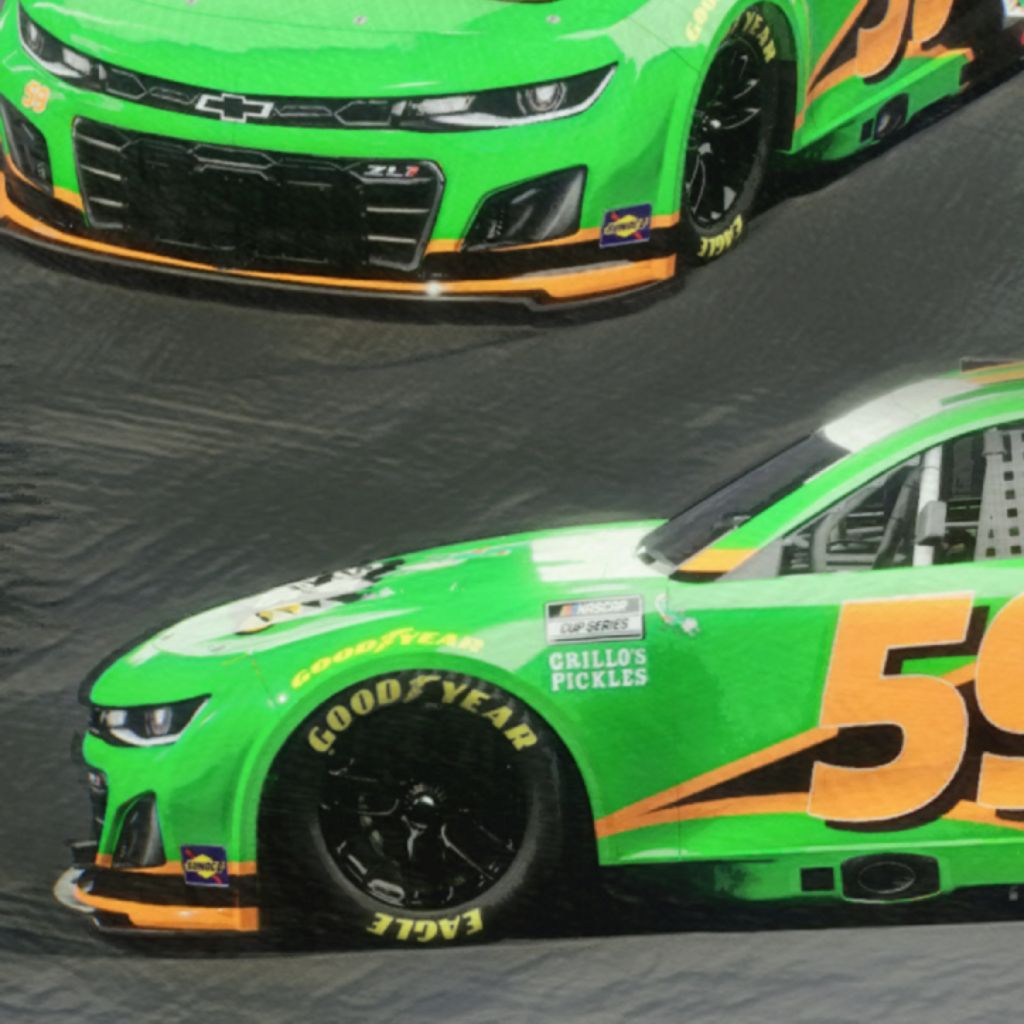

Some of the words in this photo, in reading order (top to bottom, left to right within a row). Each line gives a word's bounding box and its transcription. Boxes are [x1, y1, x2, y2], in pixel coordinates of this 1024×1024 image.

[548, 647, 648, 671] GRILLO'S
[551, 668, 649, 692] PICKLES
[366, 907, 485, 943] EAGLE
